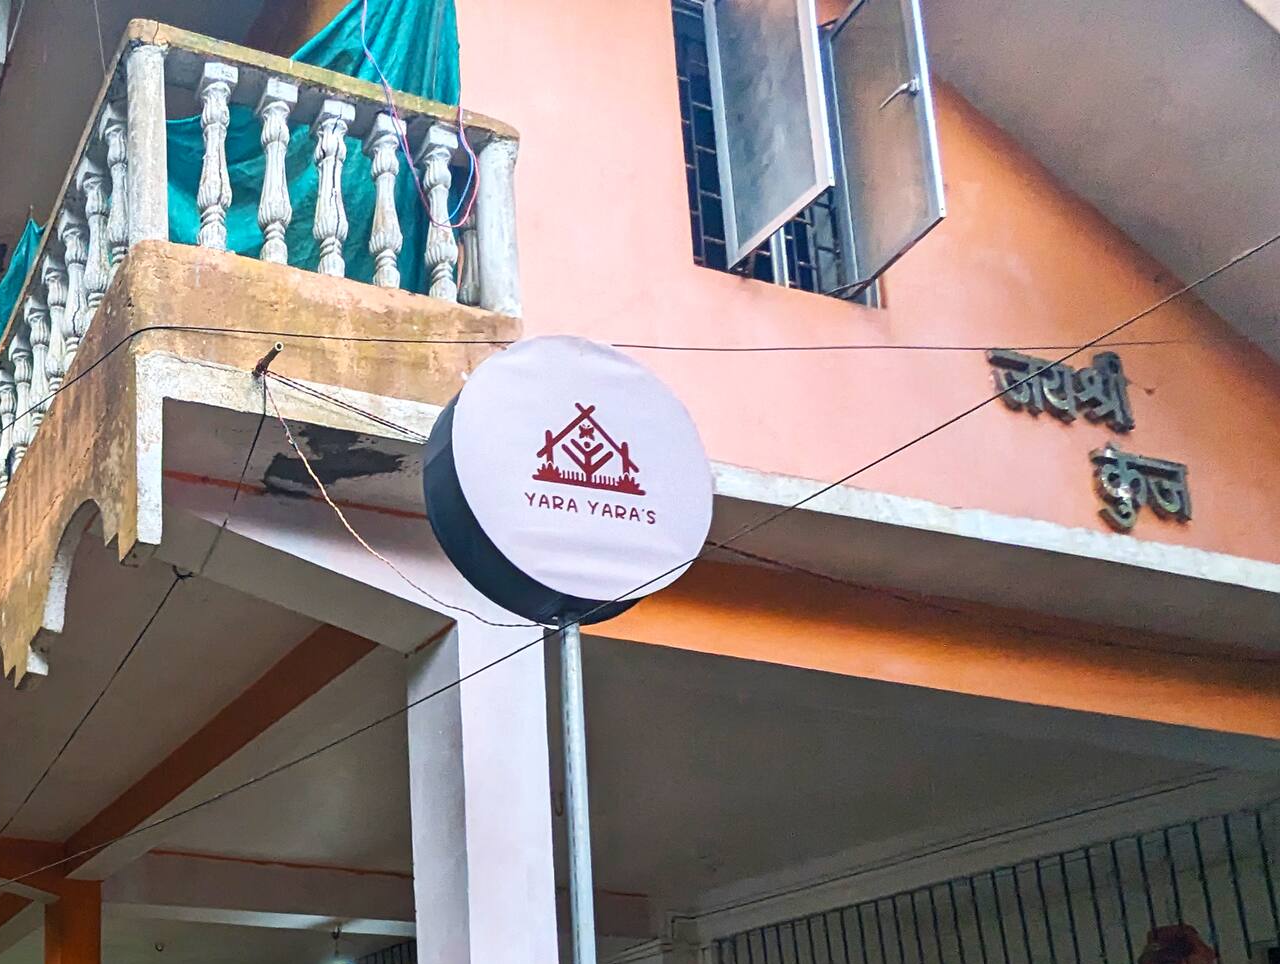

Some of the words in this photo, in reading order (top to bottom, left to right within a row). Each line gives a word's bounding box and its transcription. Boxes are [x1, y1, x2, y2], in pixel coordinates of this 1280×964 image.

[985, 349, 1135, 433] जयश्री
[524, 492, 578, 513] YARA
[587, 500, 656, 525] YARA'S
